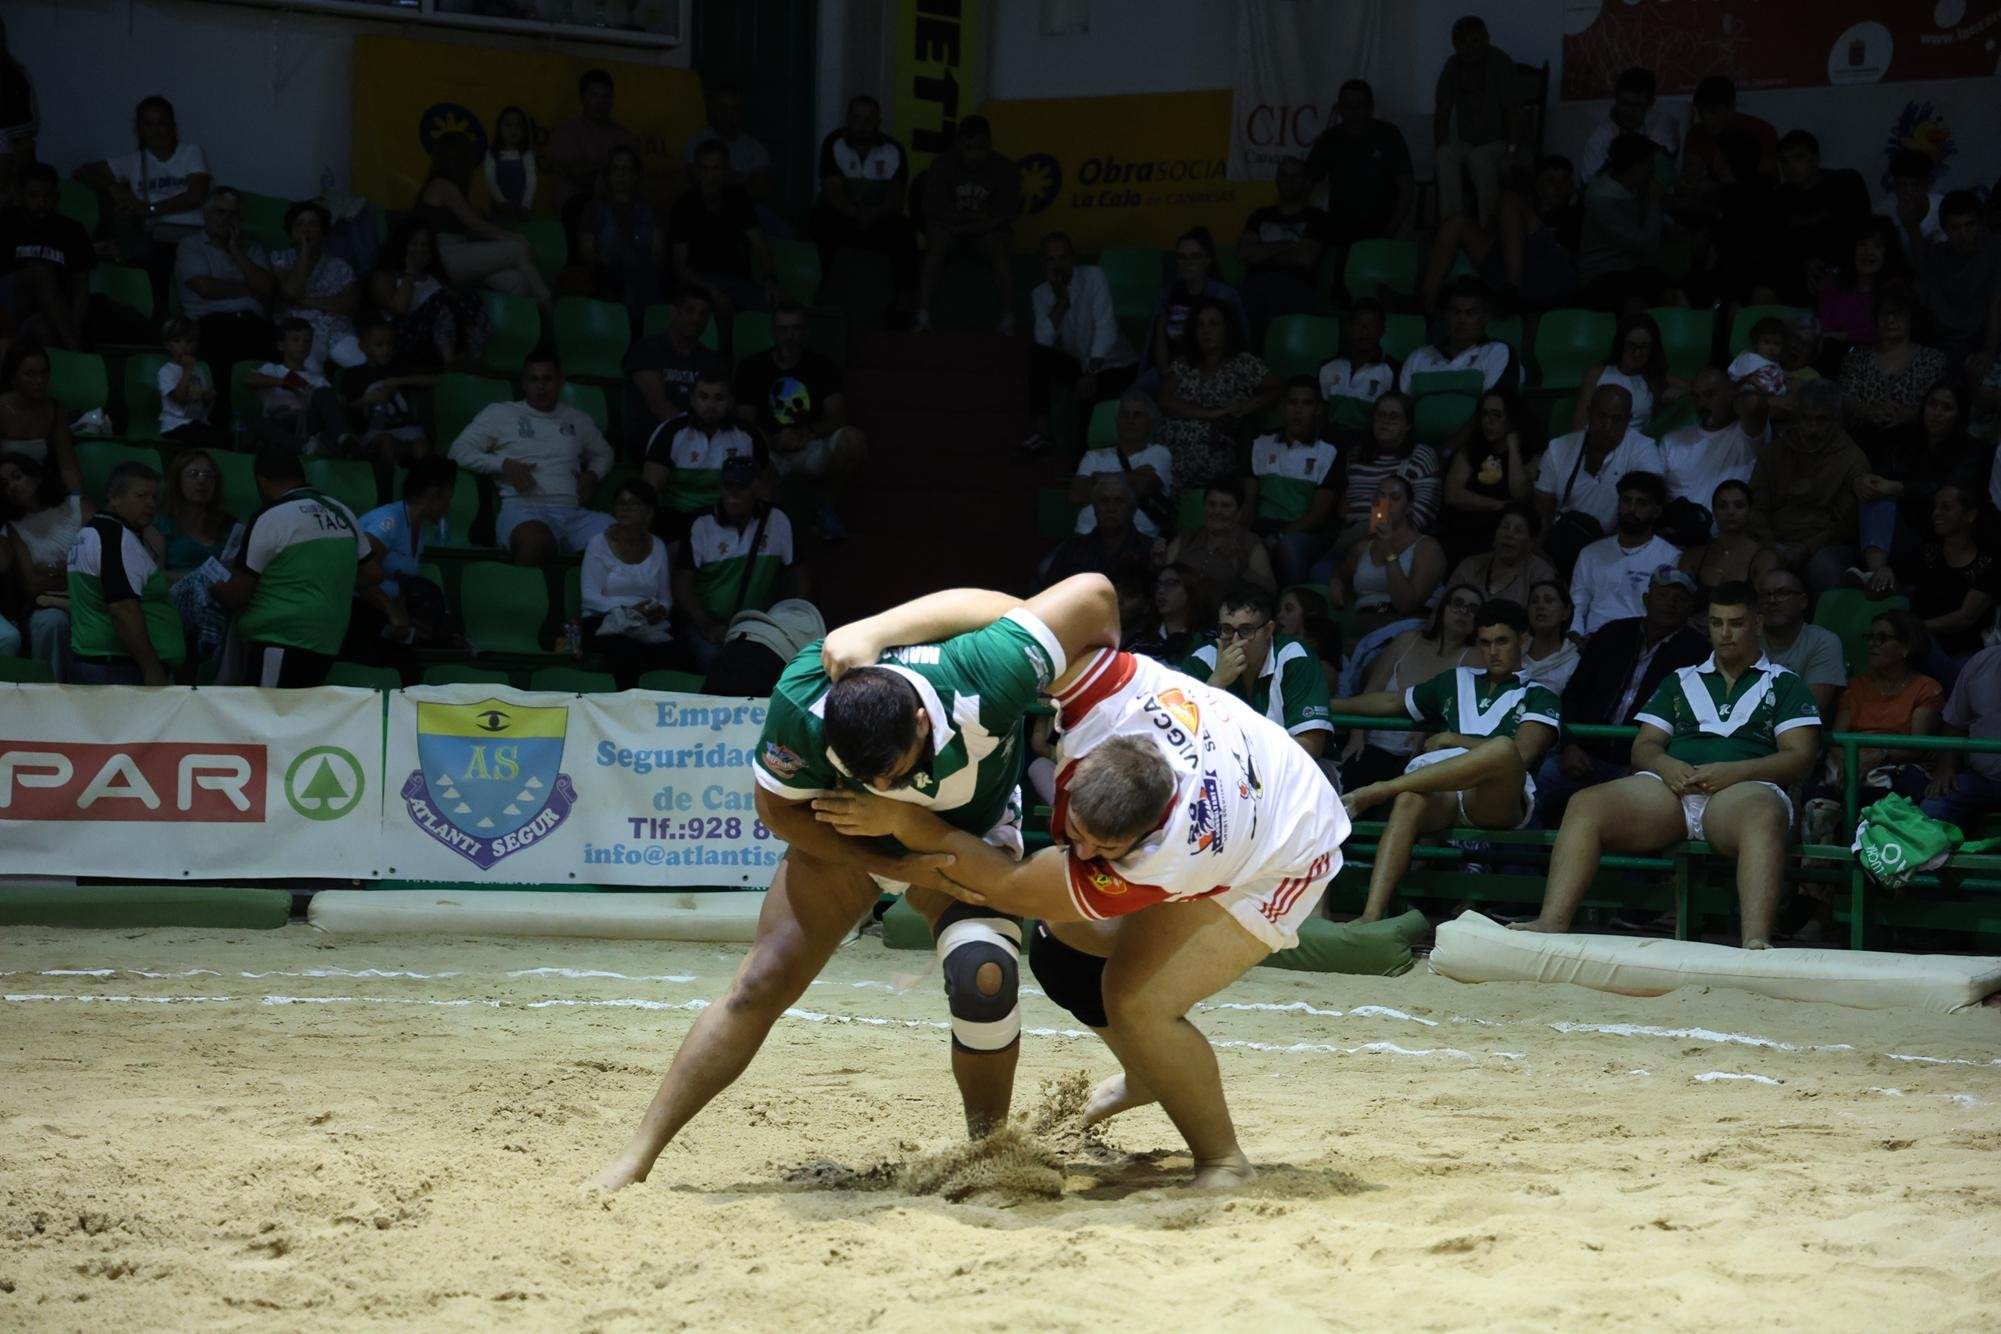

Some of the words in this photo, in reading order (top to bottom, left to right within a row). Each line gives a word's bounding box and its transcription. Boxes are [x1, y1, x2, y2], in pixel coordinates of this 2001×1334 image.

[655, 701, 767, 732] Empre
[463, 745, 522, 781] AS
[0, 750, 252, 812] PAR
[652, 785, 693, 812] de
[408, 797, 483, 858] ATLANTI
[491, 807, 561, 858] SEGUR
[752, 816, 781, 840] 8
